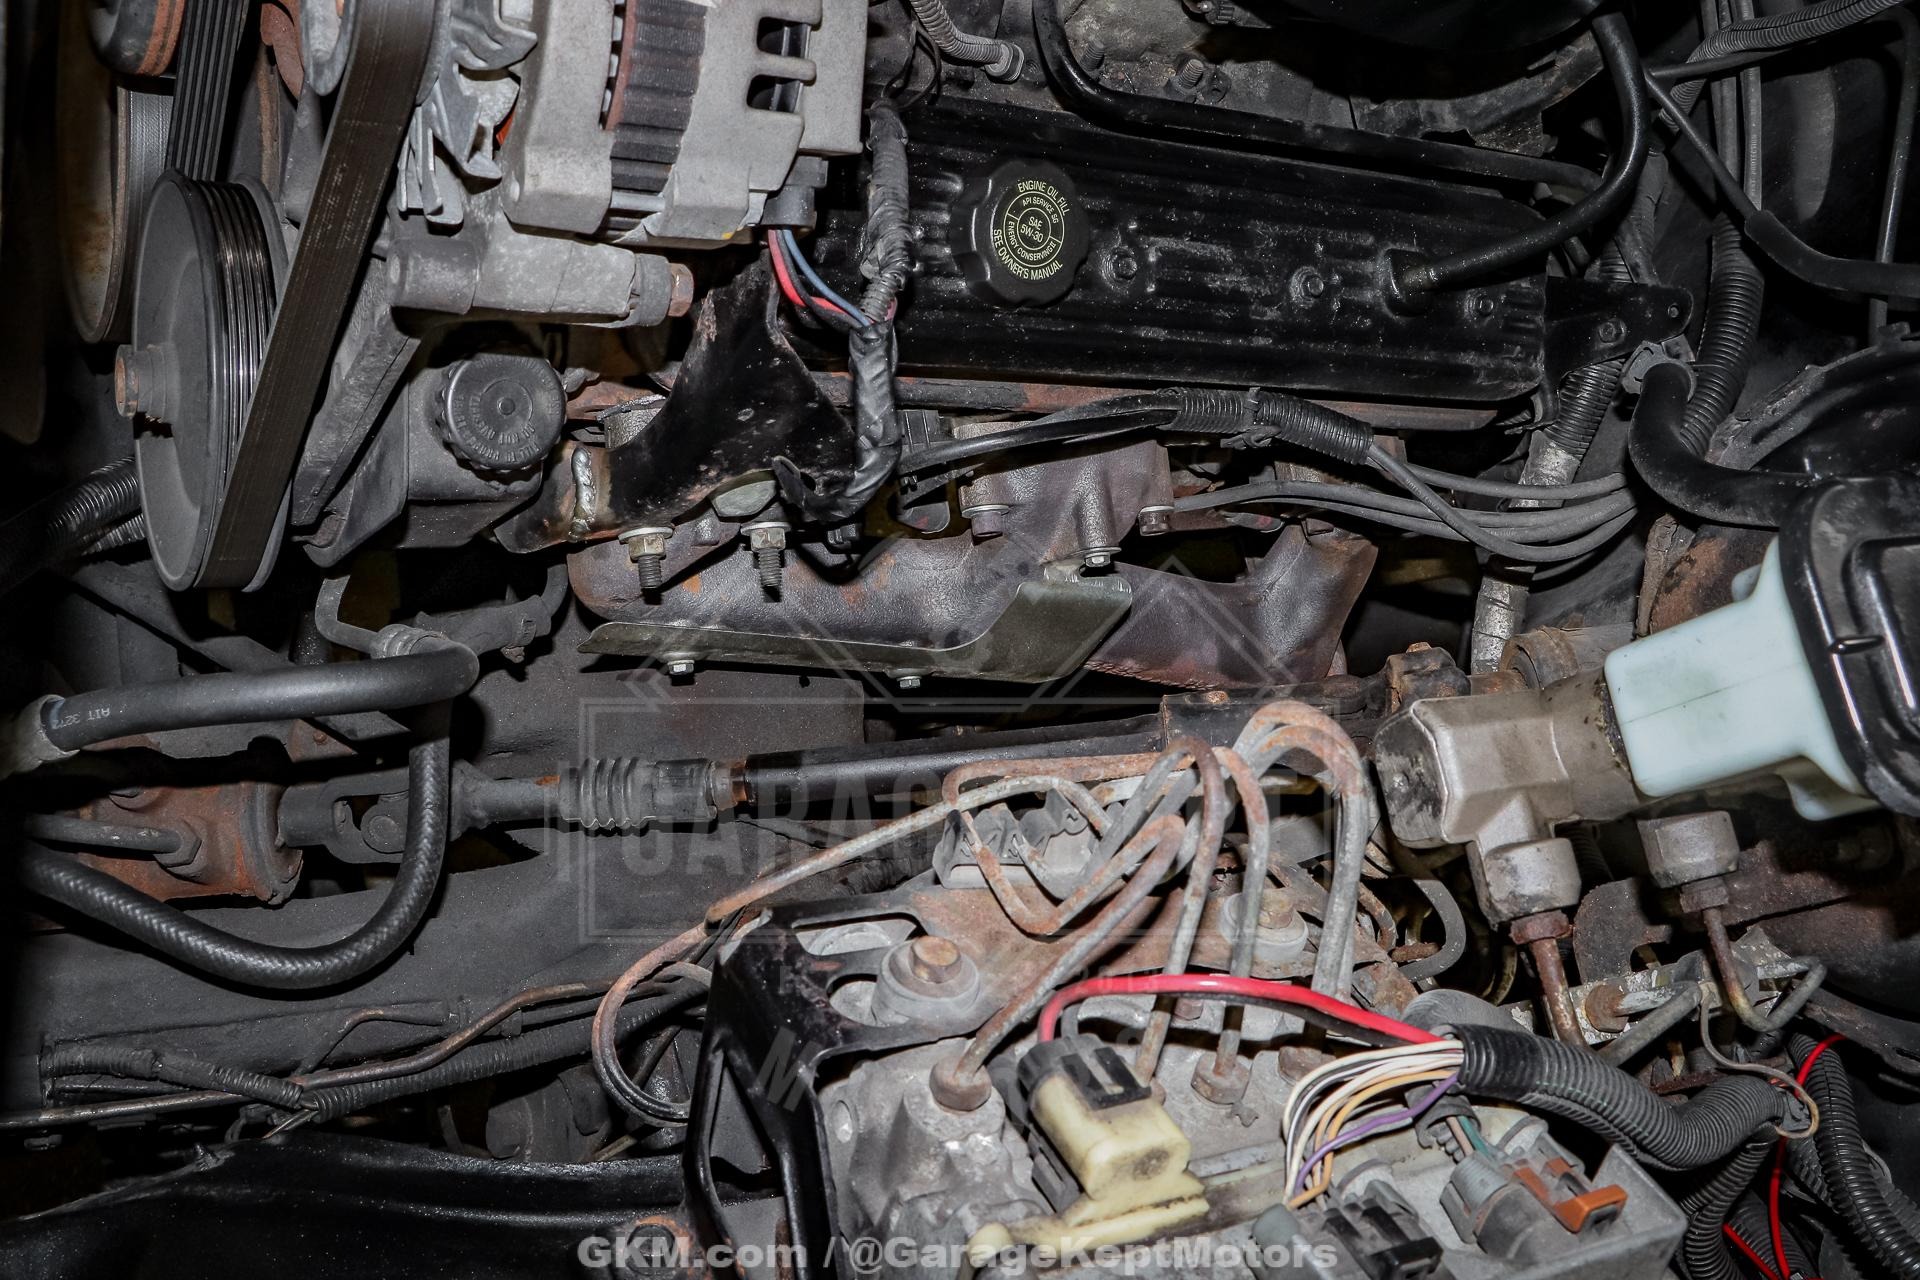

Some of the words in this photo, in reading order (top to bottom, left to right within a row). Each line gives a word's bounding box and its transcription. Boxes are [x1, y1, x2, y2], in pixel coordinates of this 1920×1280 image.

[1017, 180, 1047, 193] ENGINE
[1047, 185, 1059, 201] OIL
[1057, 196, 1070, 216] FILL
[1022, 197, 1032, 207] API
[1032, 196, 1055, 214] SERVICE
[1051, 213, 1059, 224] SG
[1020, 224, 1044, 243] 5W-30
[1028, 216, 1043, 231] SAE
[994, 229, 1004, 249] SEE
[1008, 221, 1019, 249] ENERGY
[1017, 246, 1054, 261] CONSERVING
[998, 246, 1030, 279] OWNER'S
[1030, 260, 1063, 281] MANUAL
[88, 708, 110, 720] AIT
